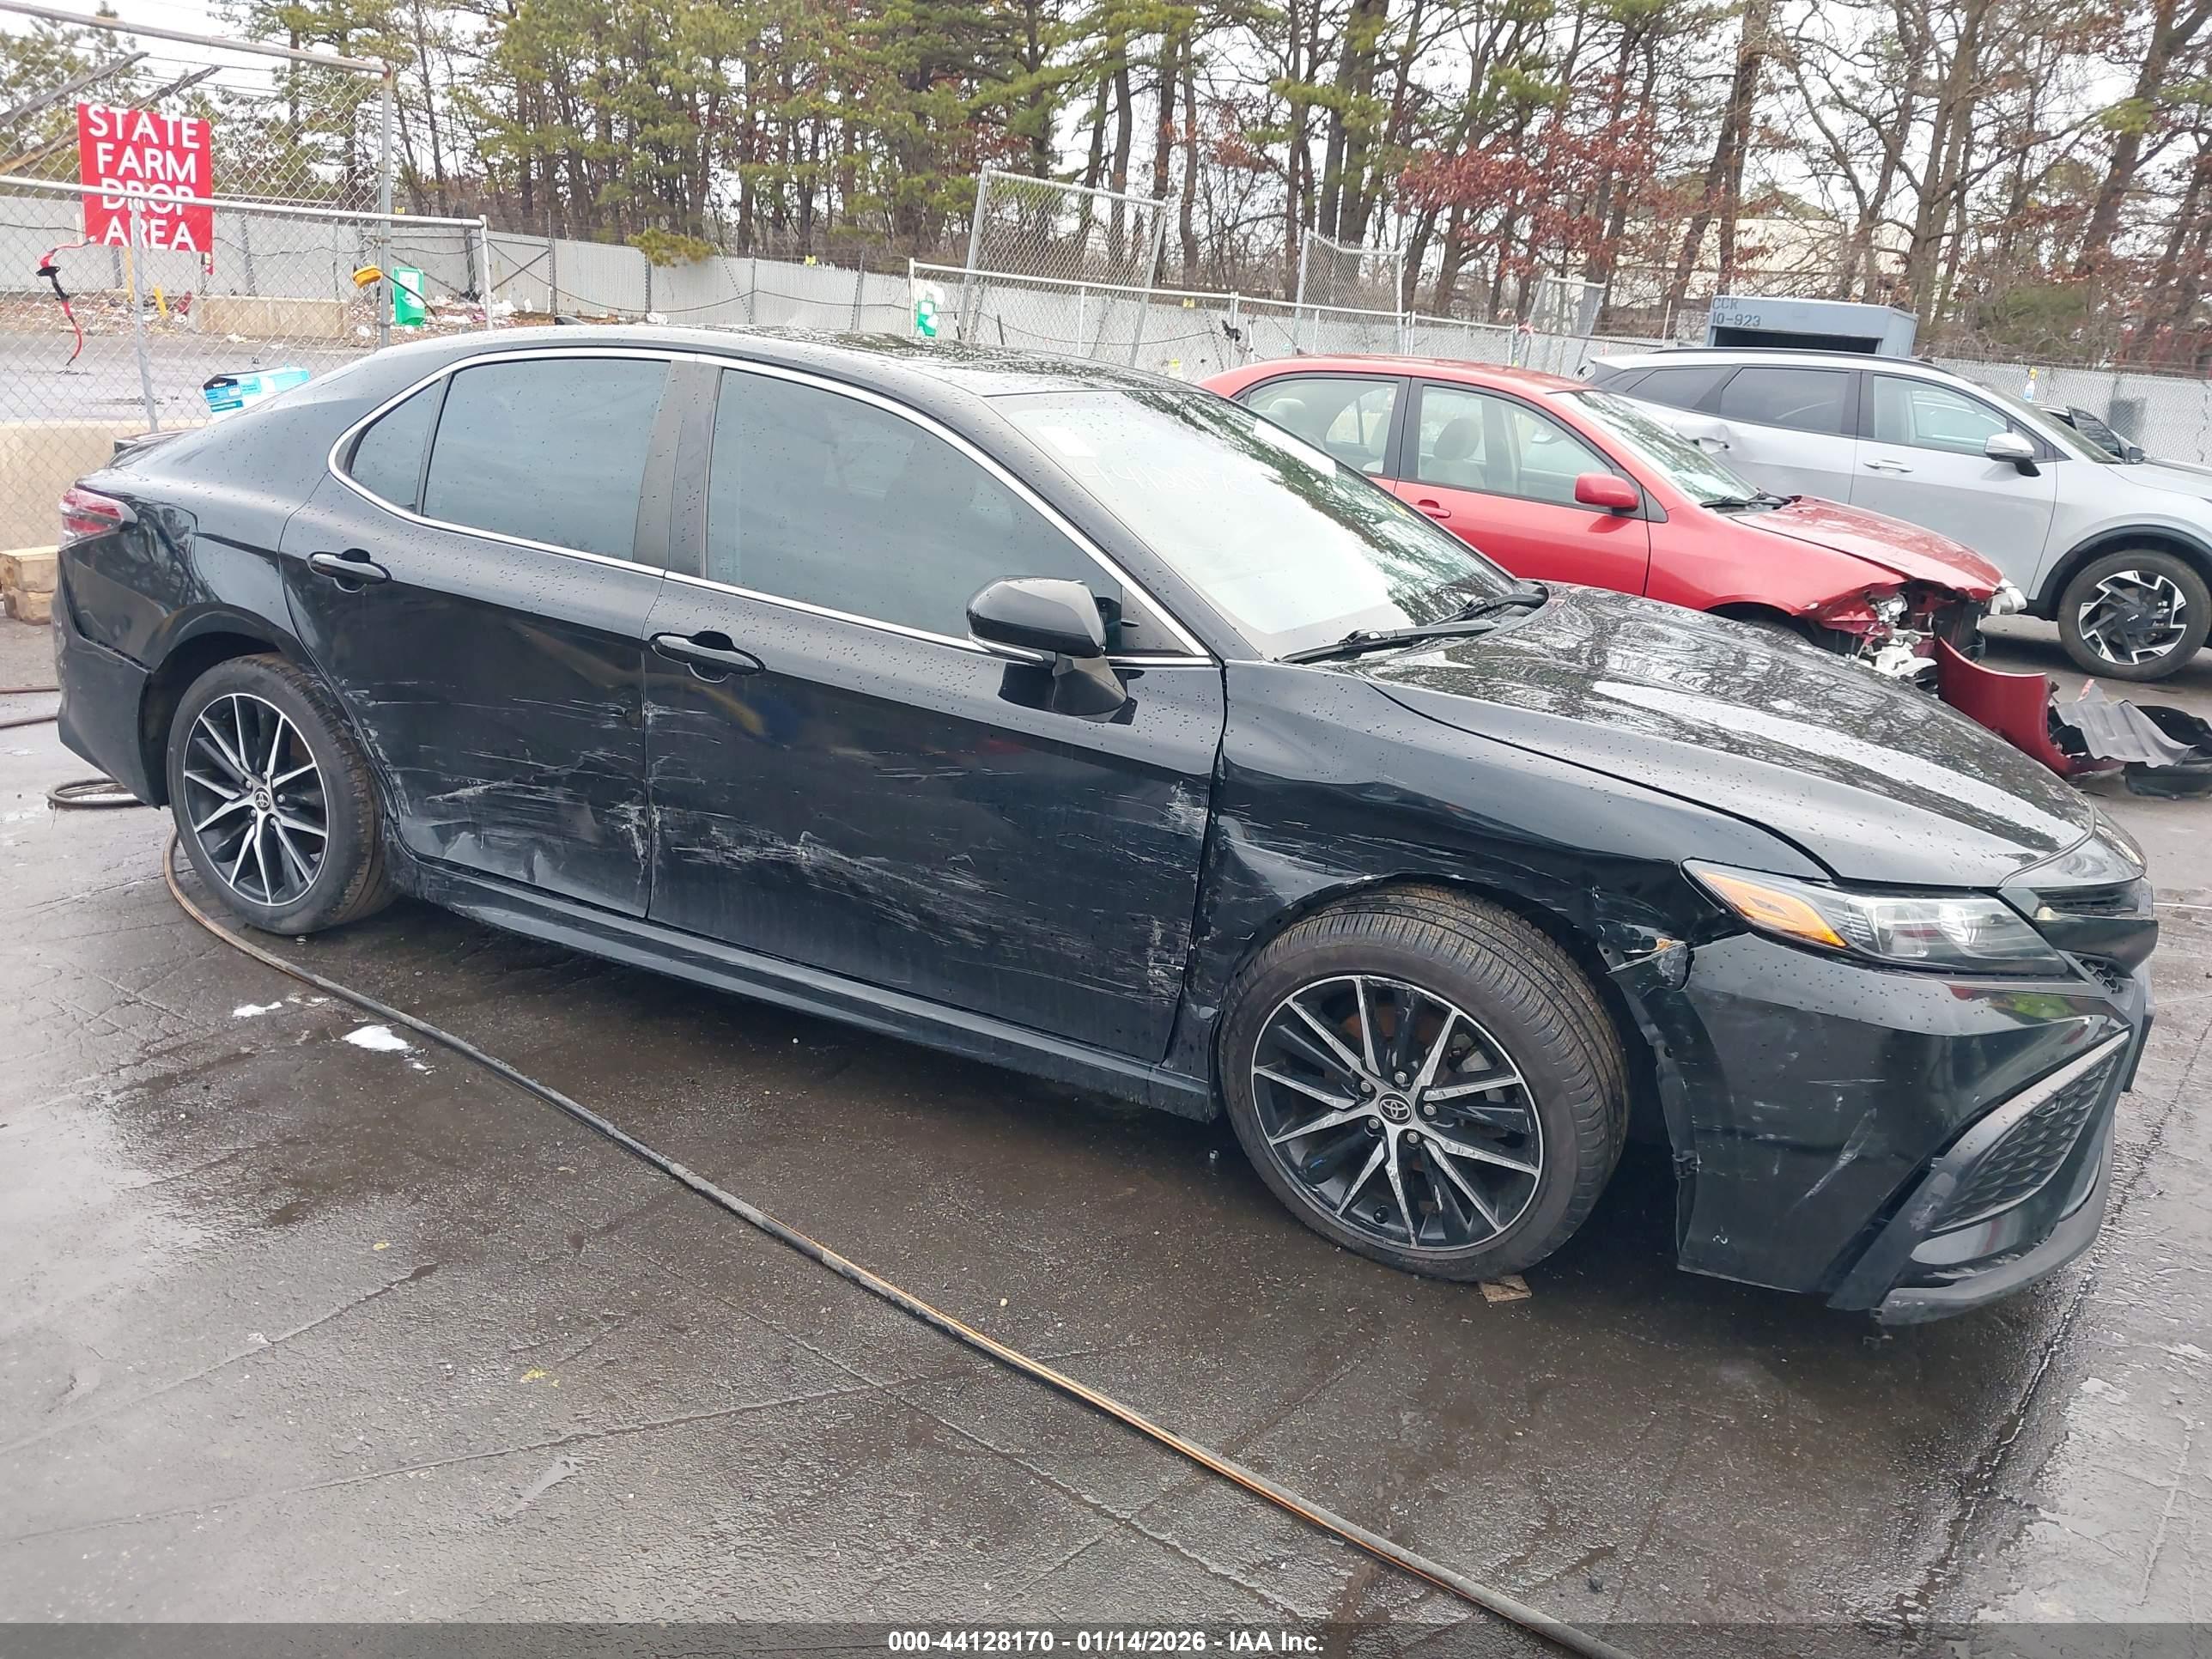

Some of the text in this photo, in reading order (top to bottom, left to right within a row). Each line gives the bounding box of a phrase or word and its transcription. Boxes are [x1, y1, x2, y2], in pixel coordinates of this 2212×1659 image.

[88, 104, 200, 149] STATE
[96, 142, 197, 184] FARM
[100, 178, 195, 216] DROP
[103, 216, 198, 252] AREA
[1712, 297, 1738, 310] CCR
[1712, 311, 1761, 327] 10-923
